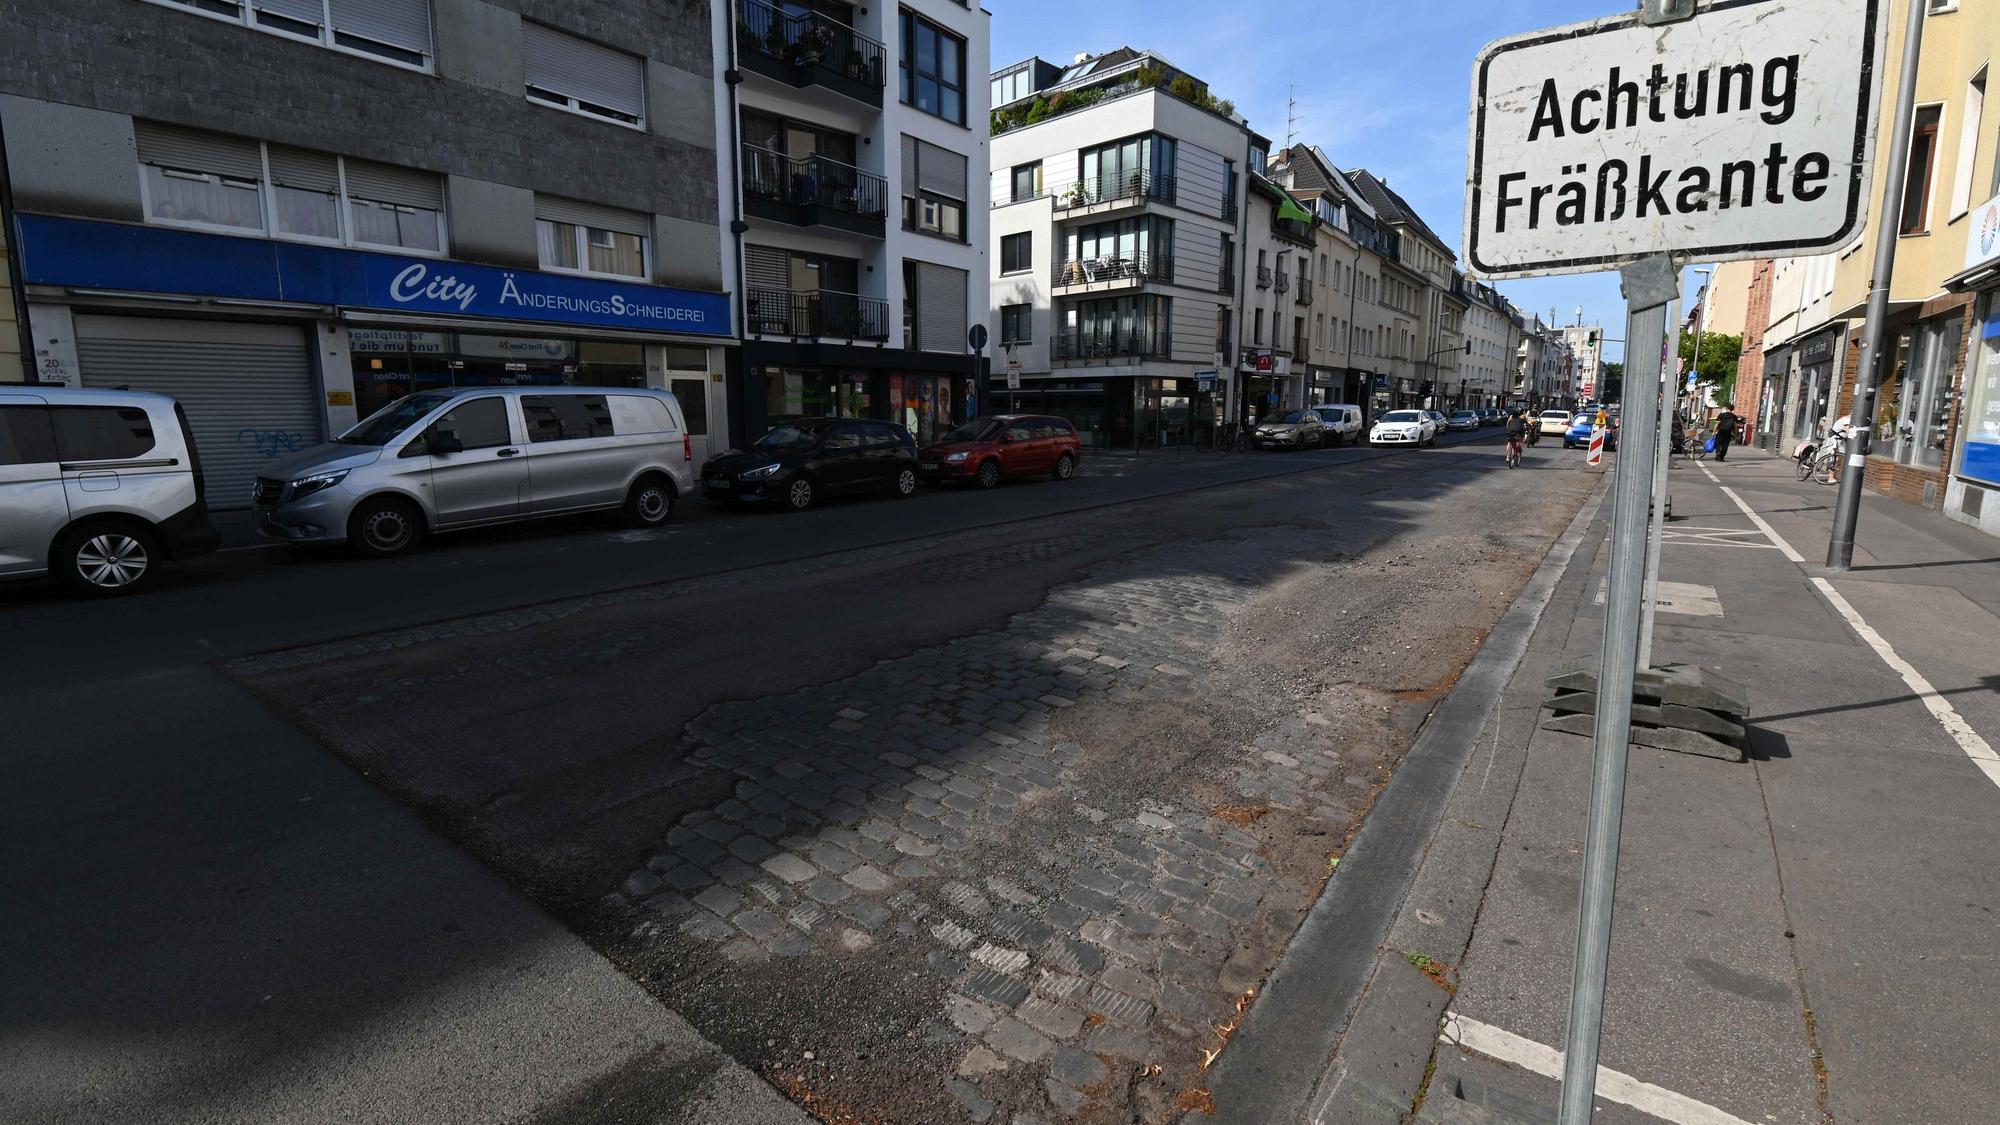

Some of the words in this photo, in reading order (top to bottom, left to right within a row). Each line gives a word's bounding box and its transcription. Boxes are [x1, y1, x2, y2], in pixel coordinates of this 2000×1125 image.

[1527, 53, 1800, 143] Achtung
[1495, 142, 1830, 233] Fräßkante
[389, 263, 478, 311] City
